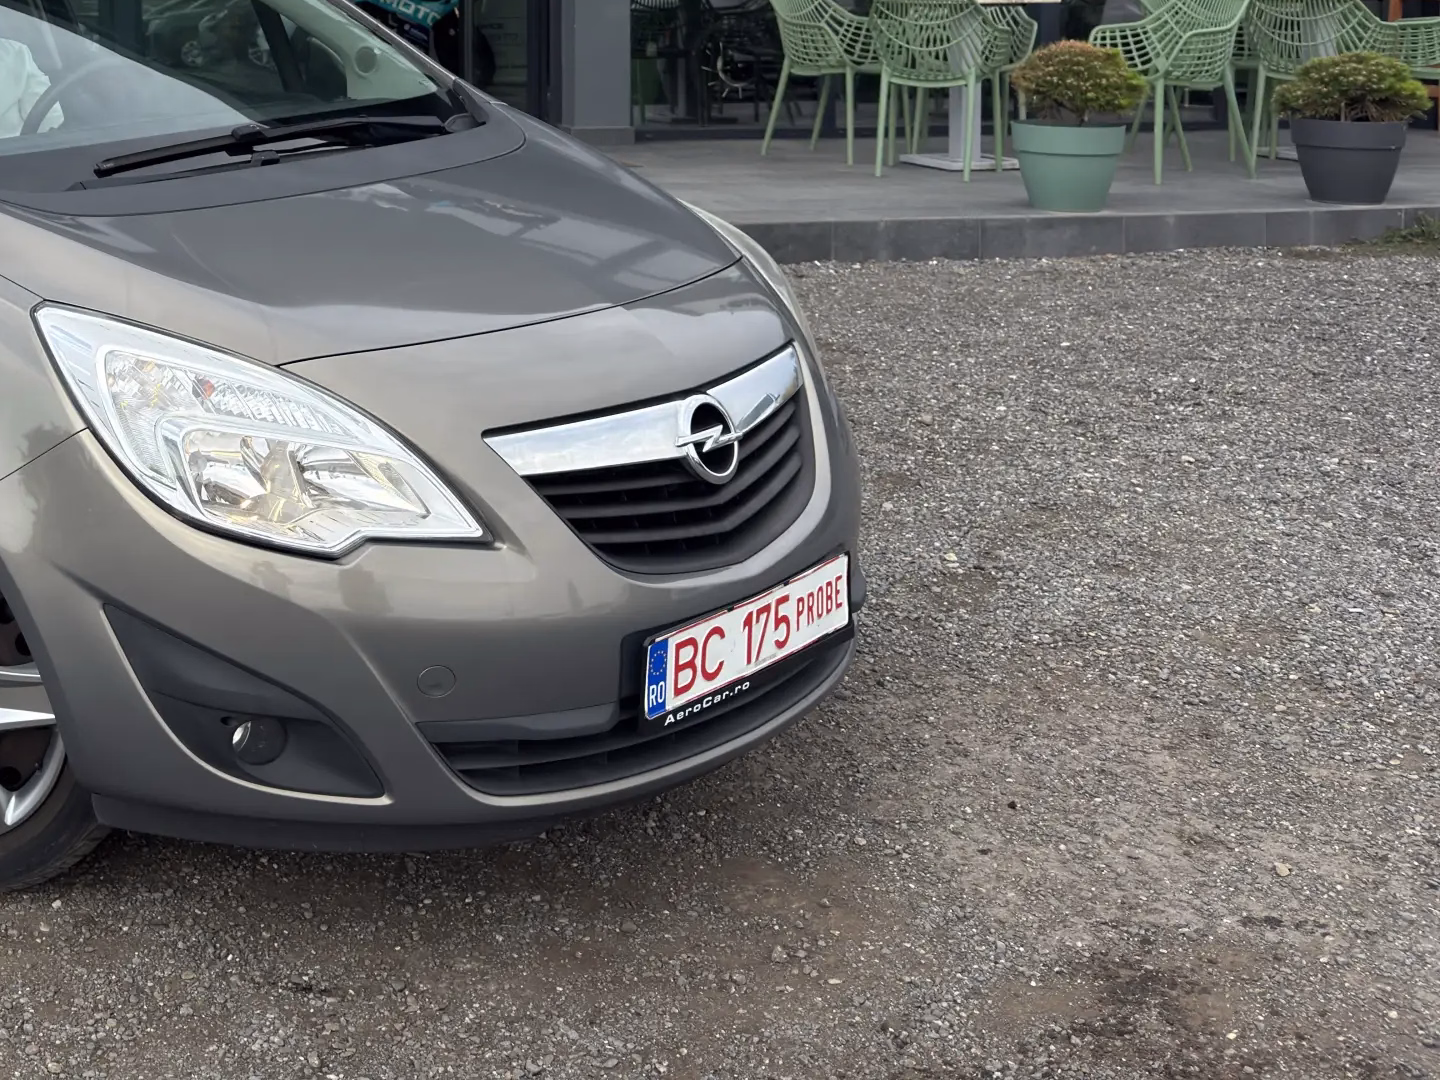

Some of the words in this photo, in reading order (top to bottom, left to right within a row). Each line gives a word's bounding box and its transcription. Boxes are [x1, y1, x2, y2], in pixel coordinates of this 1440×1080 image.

[672, 625, 726, 699] BC
[741, 594, 791, 666] 175
[795, 574, 843, 632] PROBE
[649, 681, 665, 708] RO
[664, 681, 750, 726] AeroCar.ro
